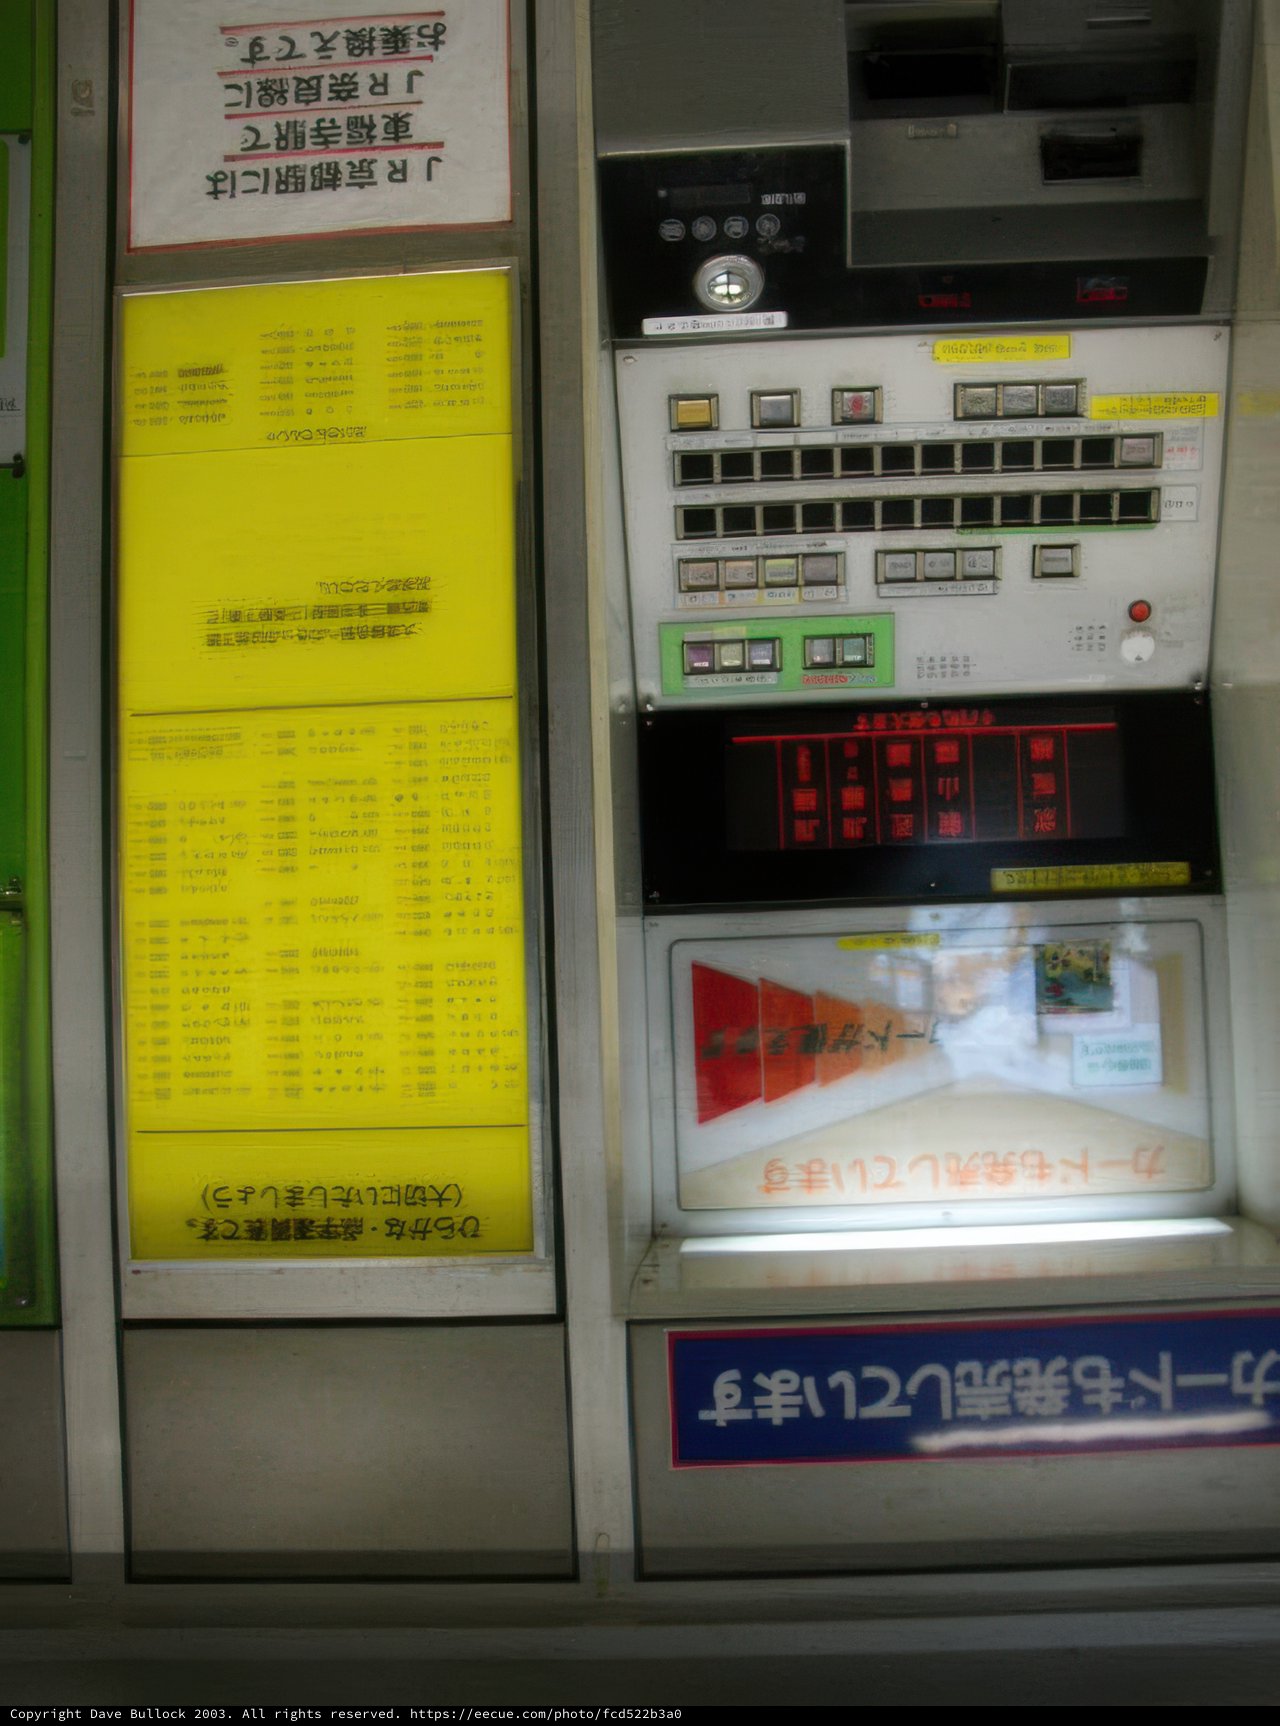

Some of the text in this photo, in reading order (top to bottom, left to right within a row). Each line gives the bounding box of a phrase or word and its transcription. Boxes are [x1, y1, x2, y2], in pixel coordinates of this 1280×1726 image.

[240, 112, 413, 151] 東福寺駅で
[698, 1348, 1280, 1427] カードも発売しています
